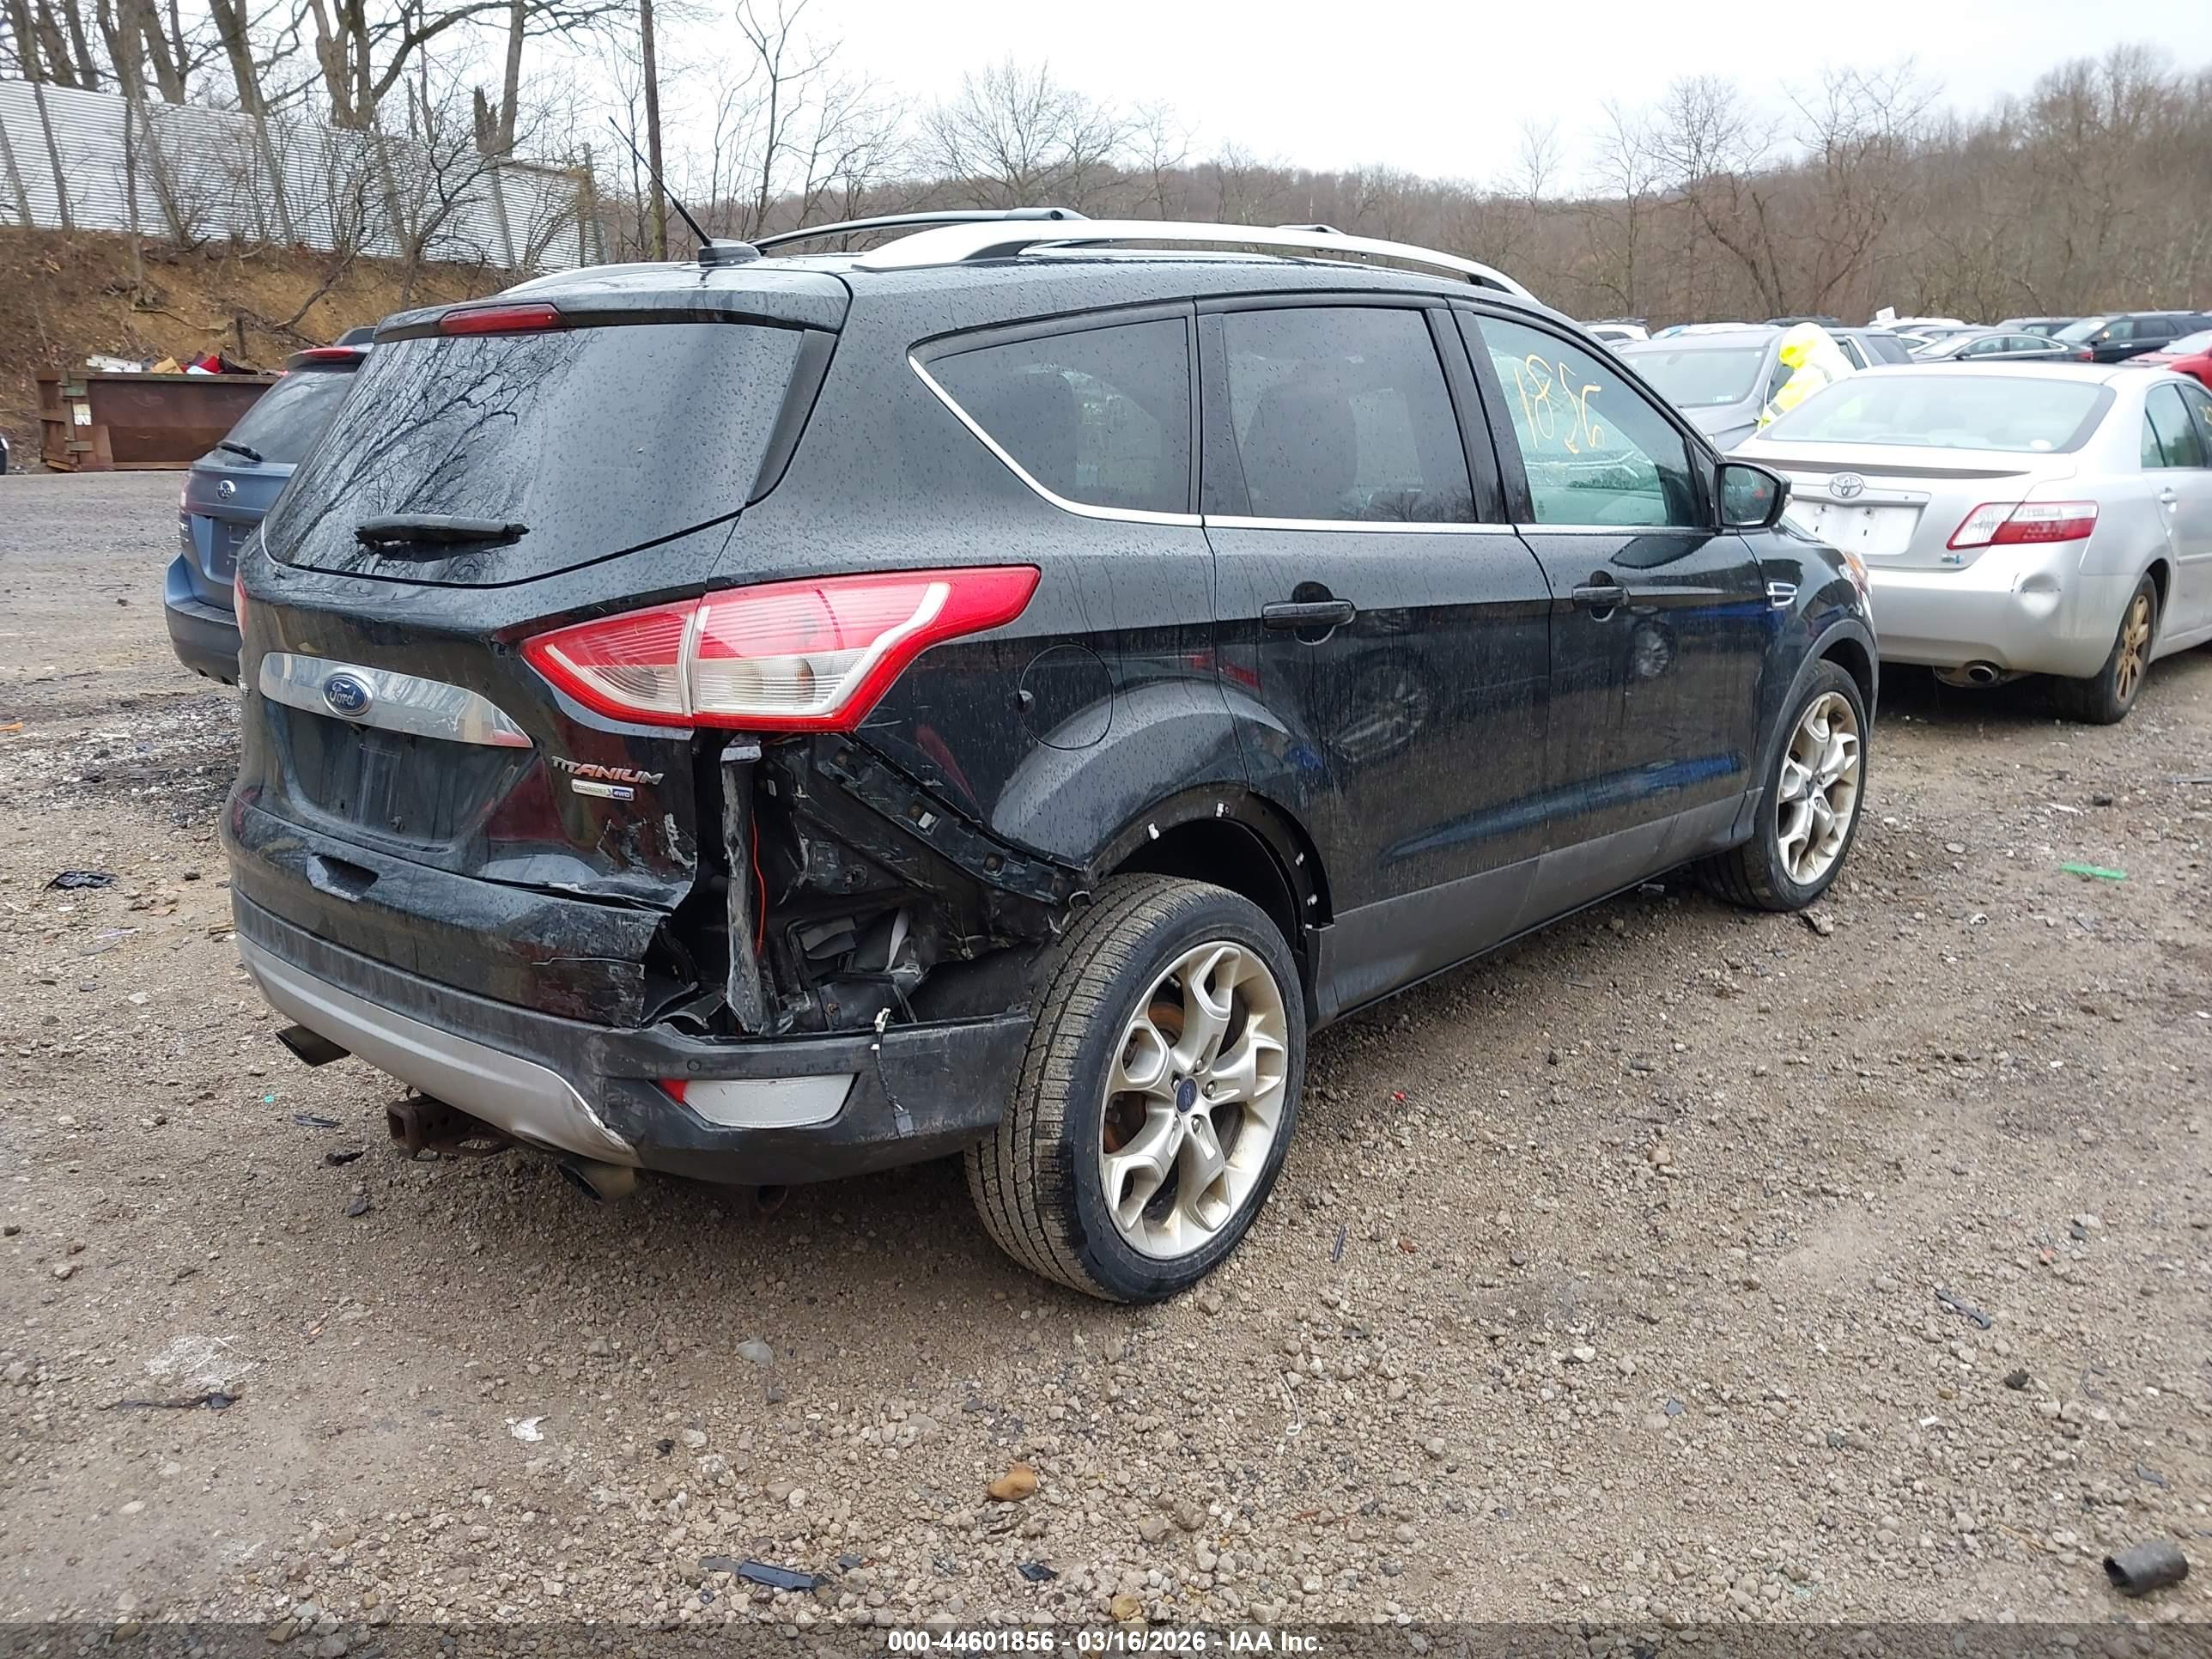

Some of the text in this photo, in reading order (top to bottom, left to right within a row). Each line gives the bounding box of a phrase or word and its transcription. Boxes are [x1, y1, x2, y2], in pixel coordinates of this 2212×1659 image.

[1514, 353, 1606, 454] 1856
[329, 681, 356, 706] Ford
[550, 755, 665, 785] TITANIUM
[613, 790, 631, 799] 4WD
